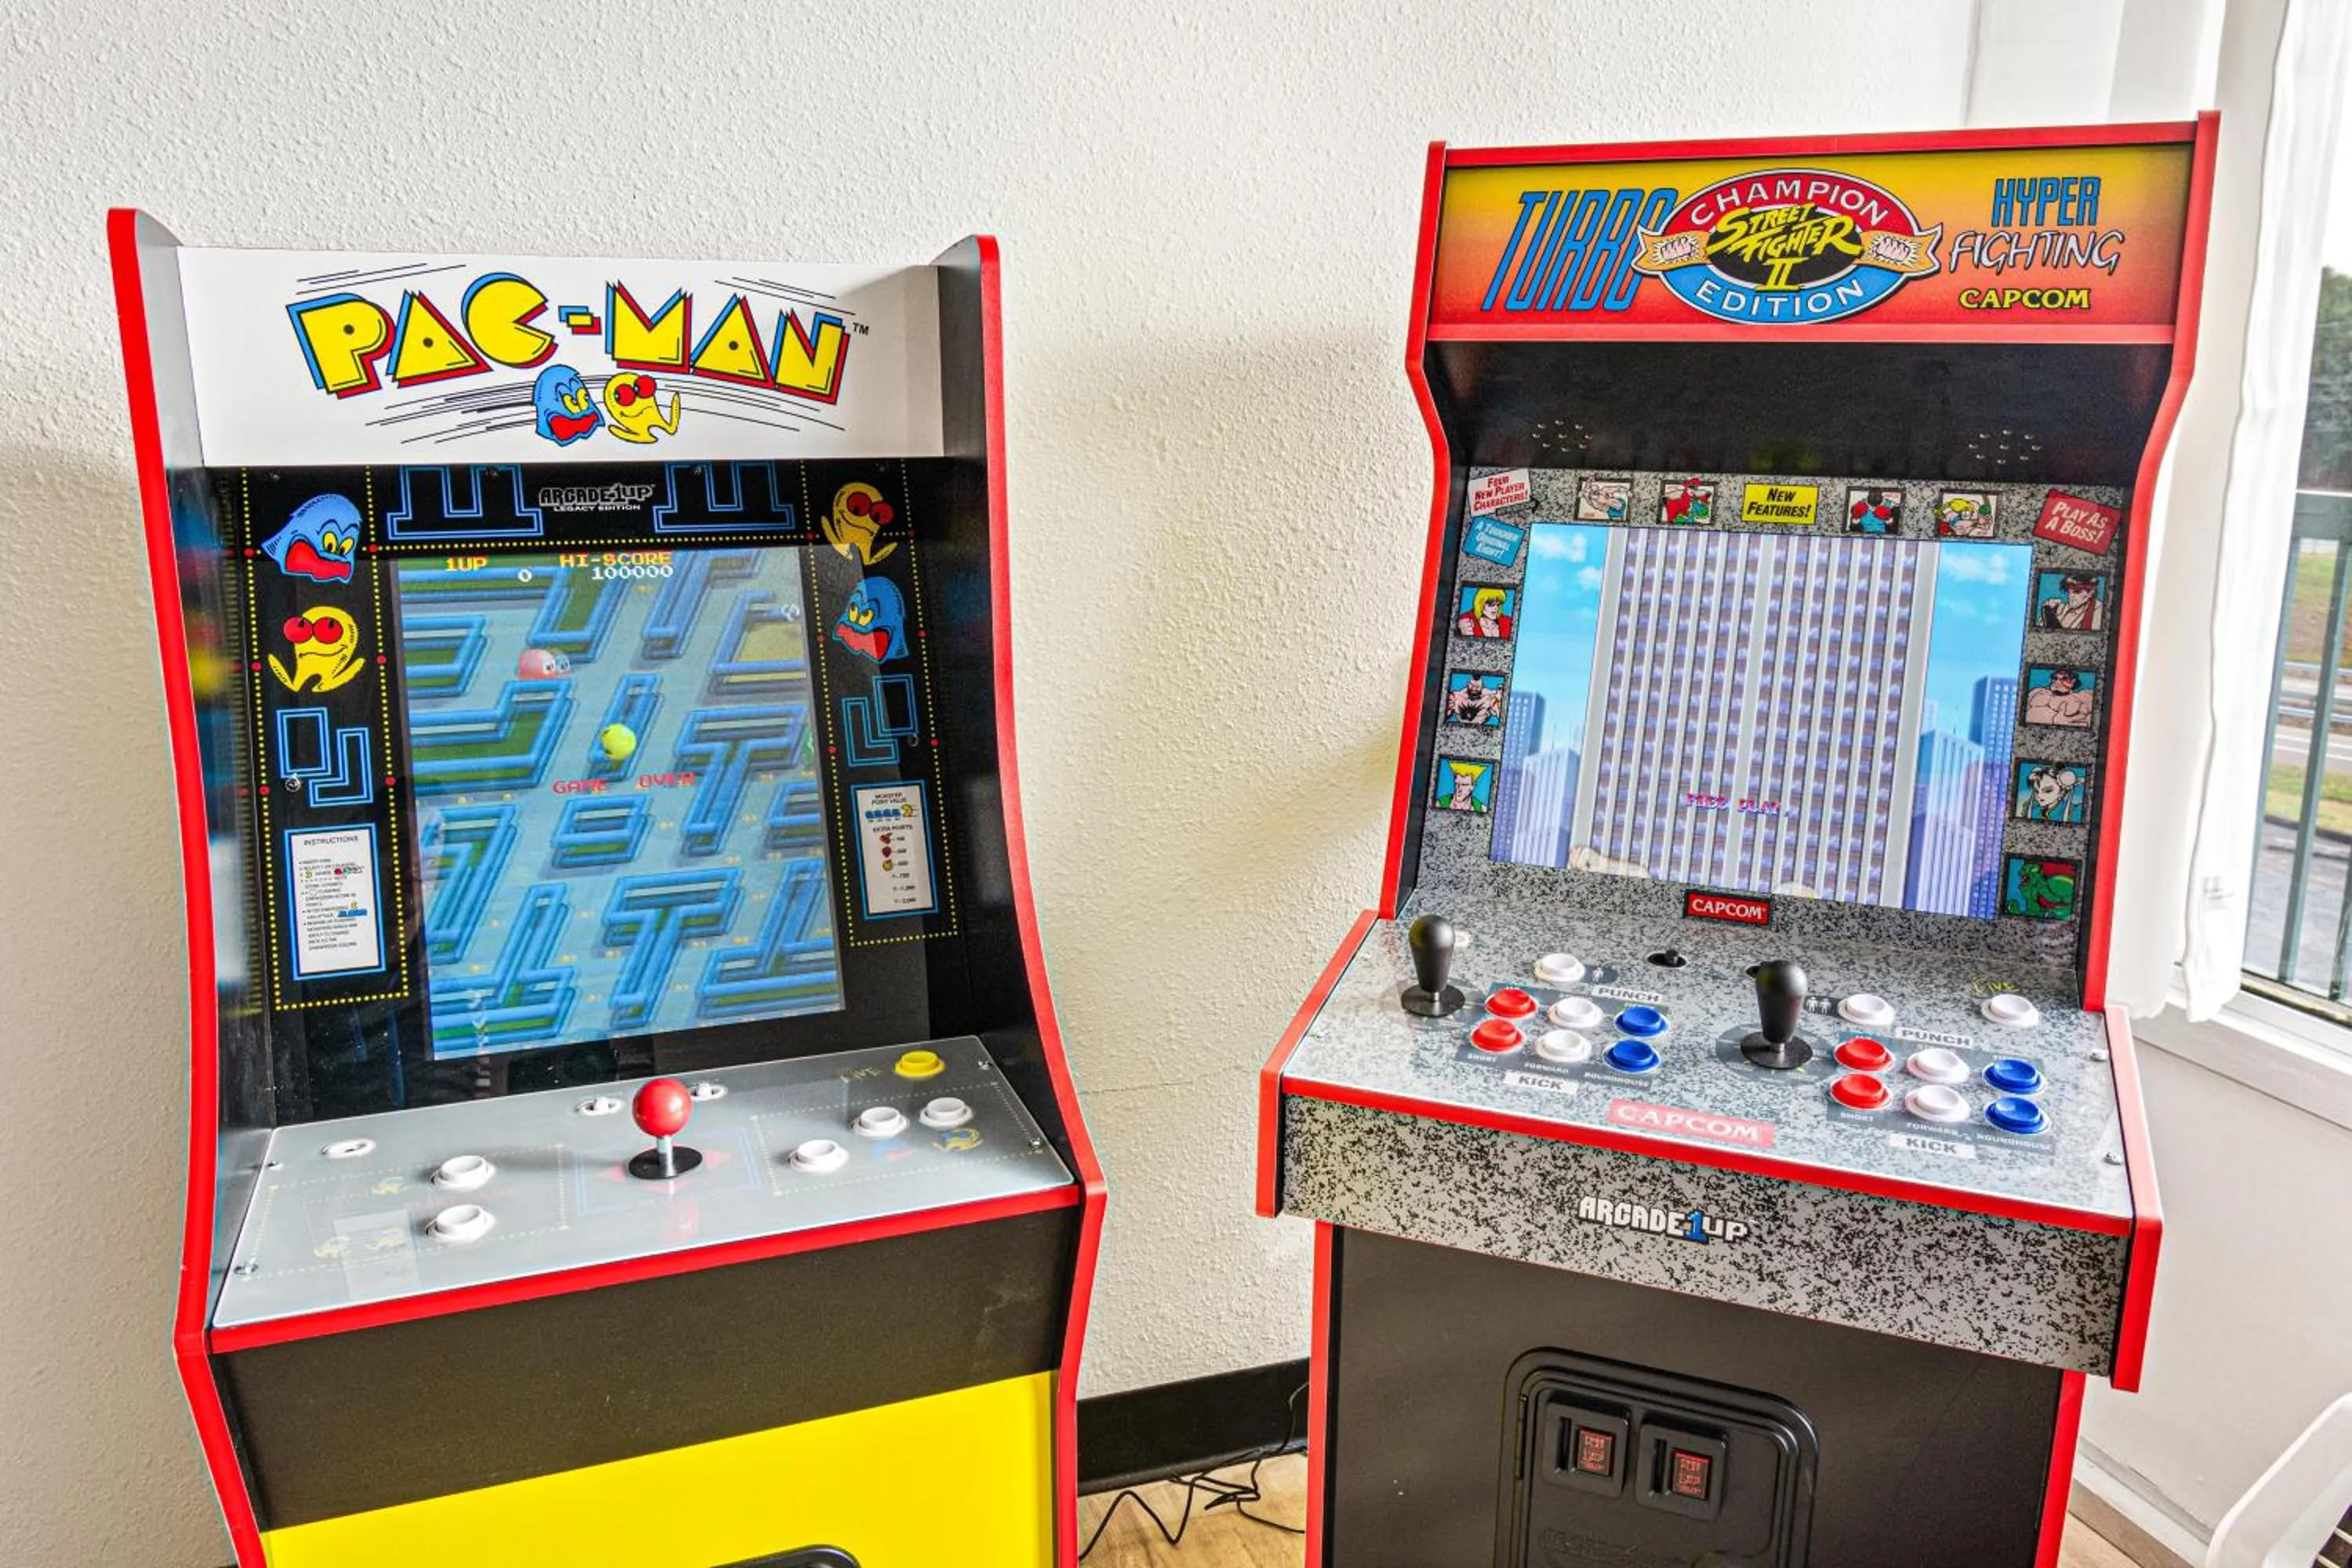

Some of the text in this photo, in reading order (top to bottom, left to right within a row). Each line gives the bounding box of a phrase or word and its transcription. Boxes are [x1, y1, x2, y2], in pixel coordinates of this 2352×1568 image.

[1690, 179, 1889, 227] CHAMPION
[1991, 176, 2102, 227] HYPER
[1706, 202, 1816, 256] STREET
[1727, 213, 1864, 263] FIGHTER
[1480, 187, 1679, 311] TURBO
[1949, 230, 2125, 276] FIGHTING
[1755, 256, 1809, 292] II
[1695, 278, 1865, 318] EDITION
[1958, 288, 2092, 310] CAPCOM
[285, 271, 851, 405] PAC-MAN
[1474, 482, 1525, 501] NEW PLAYER
[1487, 475, 1510, 488] FOUR
[539, 482, 655, 507] ARCADE1UP
[1766, 488, 1796, 502] NEW
[597, 503, 641, 512] EDITION
[1747, 501, 1812, 518] FEATURES!
[2051, 501, 2109, 529] PLAY AS
[2044, 516, 2105, 544] A BOSS!
[445, 556, 488, 572] 1UP
[558, 551, 673, 568] HI-SCORE
[517, 568, 533, 583] 0
[591, 564, 674, 581] 100000
[551, 771, 696, 794] GAME OVER
[1691, 898, 1763, 920] CAPCOM
[1598, 987, 1661, 1003] PUNCH
[1901, 1029, 1970, 1046] PUNCH
[1518, 1075, 1563, 1091] KICK
[1617, 1105, 1760, 1142] CAPCOM
[1905, 1137, 1958, 1155] KICK
[1577, 1195, 1750, 1244] ARCADE1UP
